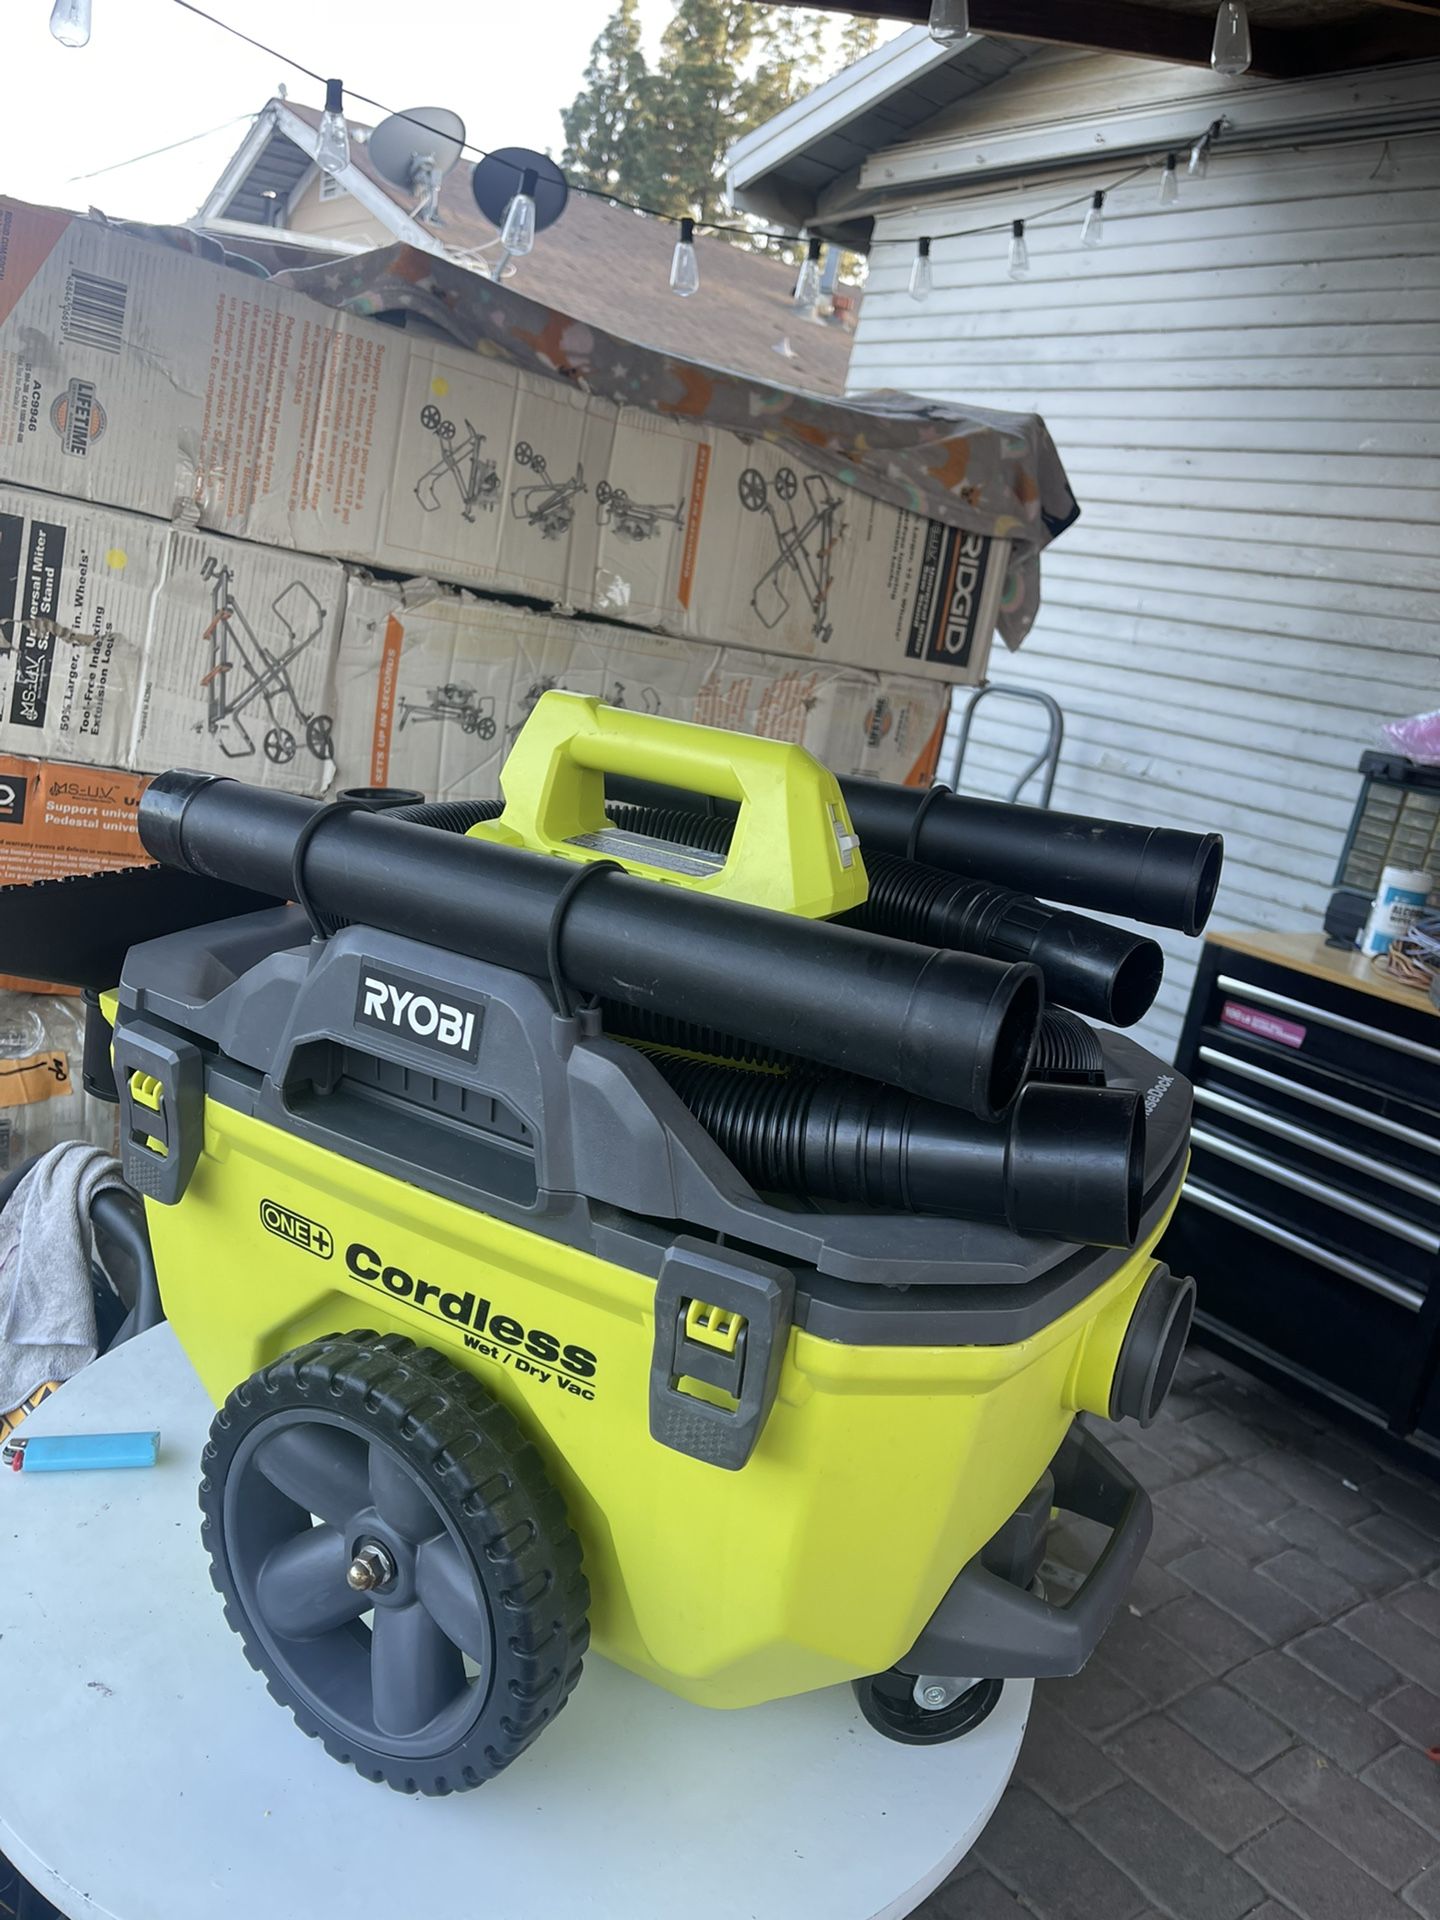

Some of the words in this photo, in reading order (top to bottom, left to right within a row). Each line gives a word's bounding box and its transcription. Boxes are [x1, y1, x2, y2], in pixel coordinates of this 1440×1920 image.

[213, 294, 226, 344] segundos
[230, 297, 237, 310] un
[253, 304, 260, 317] de
[223, 313, 236, 357] plegado
[236, 301, 251, 357] Liberación
[280, 316, 295, 368] Pedestal
[299, 320, 310, 360] modèle
[315, 324, 321, 337] en
[210, 356, 219, 370] En
[234, 360, 242, 374] de
[264, 312, 284, 393] ingleteadoras
[307, 340, 319, 387] quelques
[362, 341, 373, 384] onglets
[371, 344, 385, 391] Support
[221, 360, 229, 381] más
[255, 362, 265, 385] 50%
[350, 363, 358, 385] plus
[28, 380, 42, 431] AC9946
[200, 372, 216, 441] comparación
[216, 384, 227, 418] rápido
[252, 388, 260, 410] más
[272, 370, 285, 423] universal
[344, 388, 355, 429] grandes
[356, 396, 366, 427] Roues
[70, 384, 94, 455] LIFETIME
[299, 391, 311, 438] secondes
[323, 415, 329, 427] en
[364, 394, 376, 445] universel
[214, 430, 222, 442] Se
[246, 414, 256, 455] grandes
[268, 426, 277, 452] para
[354, 430, 361, 442] de
[255, 446, 262, 459] de
[316, 452, 324, 479] seule
[350, 446, 360, 464] 305
[360, 448, 369, 474] pour
[226, 451, 242, 518] herramientas
[252, 463, 262, 481] 305
[262, 455, 275, 494] sierras
[326, 460, 334, 485] outil
[356, 478, 365, 500] scie
[238, 467, 251, 514] Bloqueos
[290, 499, 295, 511] au
[345, 489, 353, 505] (12
[32, 530, 46, 572] Miter
[40, 567, 54, 613] Stand
[946, 535, 983, 655] RIDGID
[64, 654, 80, 699] Larger,
[72, 612, 82, 628] in.
[381, 648, 395, 710] SECONDS
[380, 713, 387, 727] IN
[378, 730, 385, 748] UP
[375, 751, 384, 783] SETS
[54, 781, 114, 799] MS-UV
[44, 814, 99, 830] Pedestal
[46, 801, 99, 817] Support
[363, 977, 475, 1051] RYOBI
[265, 1208, 330, 1254] ONE+
[345, 1243, 598, 1378] Cordless
[464, 1334, 499, 1360] Wet
[503, 1351, 512, 1364] /
[515, 1357, 552, 1383] Dry
[557, 1375, 597, 1401] Vac
